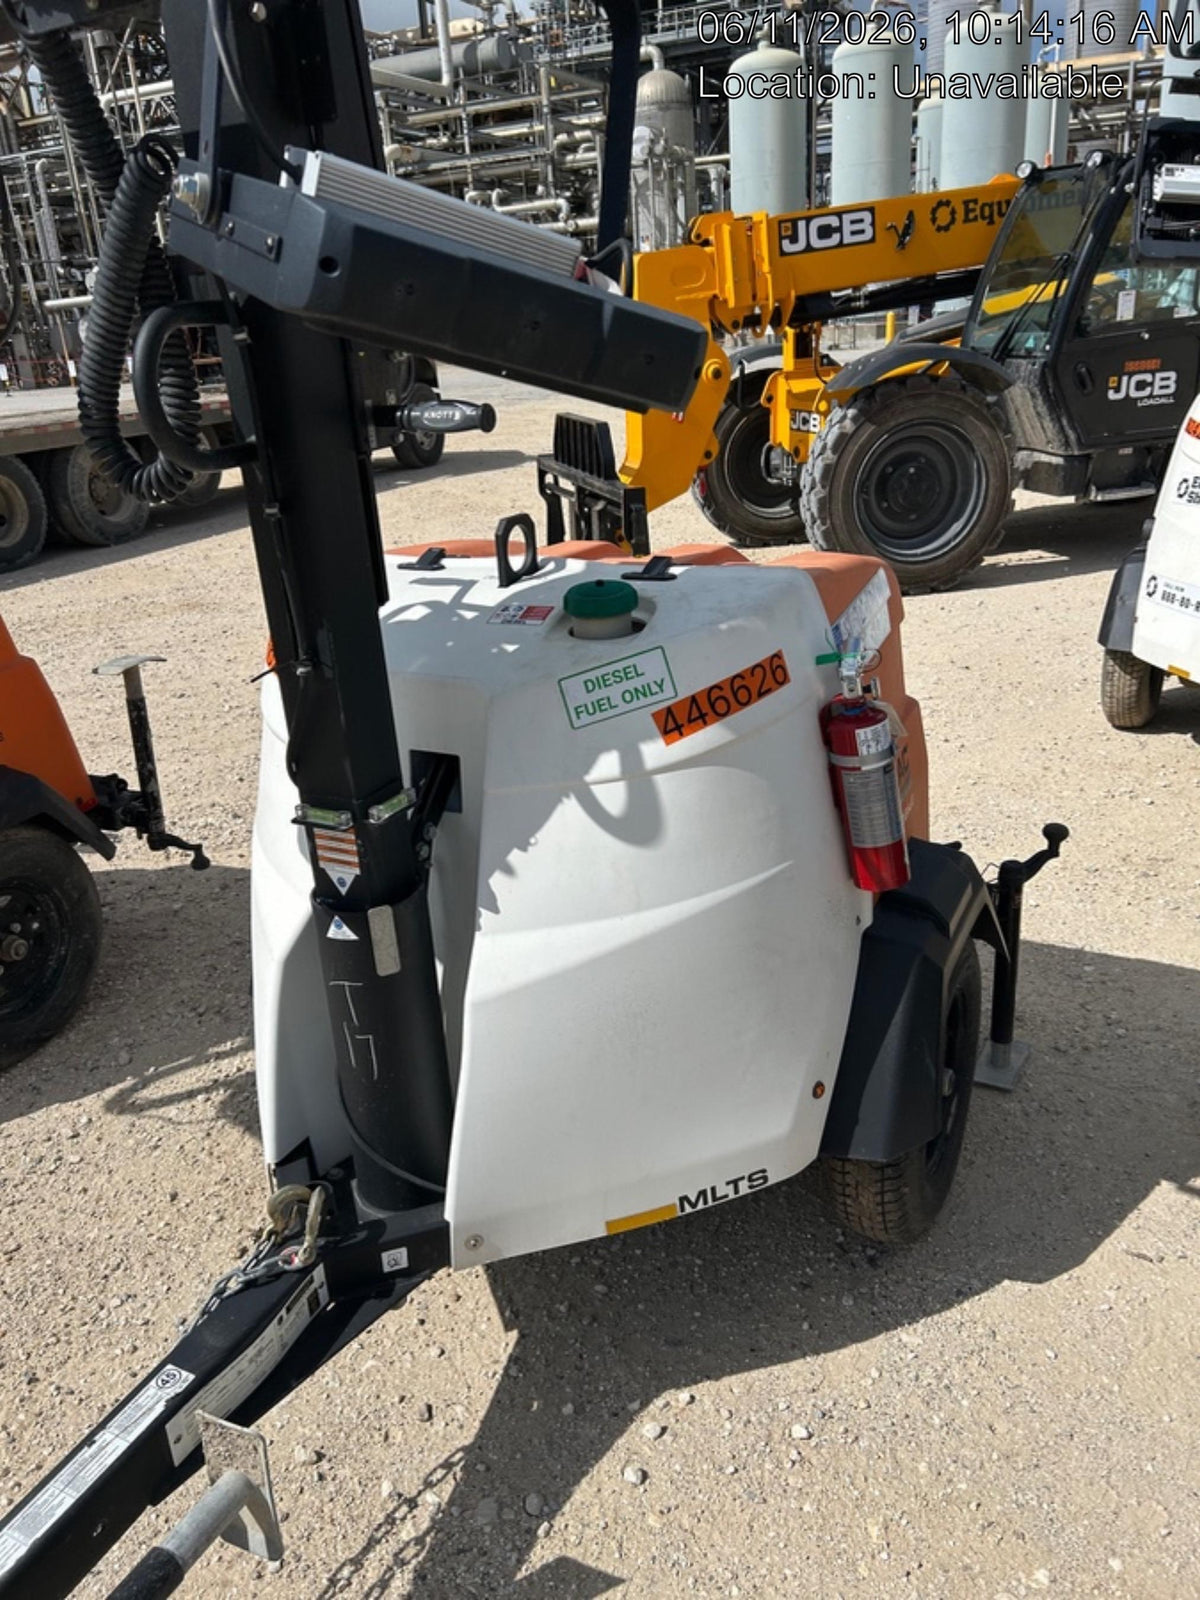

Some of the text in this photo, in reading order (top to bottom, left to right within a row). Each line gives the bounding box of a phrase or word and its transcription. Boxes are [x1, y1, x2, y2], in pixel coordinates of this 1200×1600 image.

[780, 210, 874, 254] JCB
[1107, 371, 1177, 400] JCB
[790, 410, 820, 432] JCB
[573, 678, 667, 721] FUEL ONLY
[583, 663, 645, 694] DIESEL
[662, 652, 788, 737] 446626
[678, 1168, 769, 1213] MLTS
